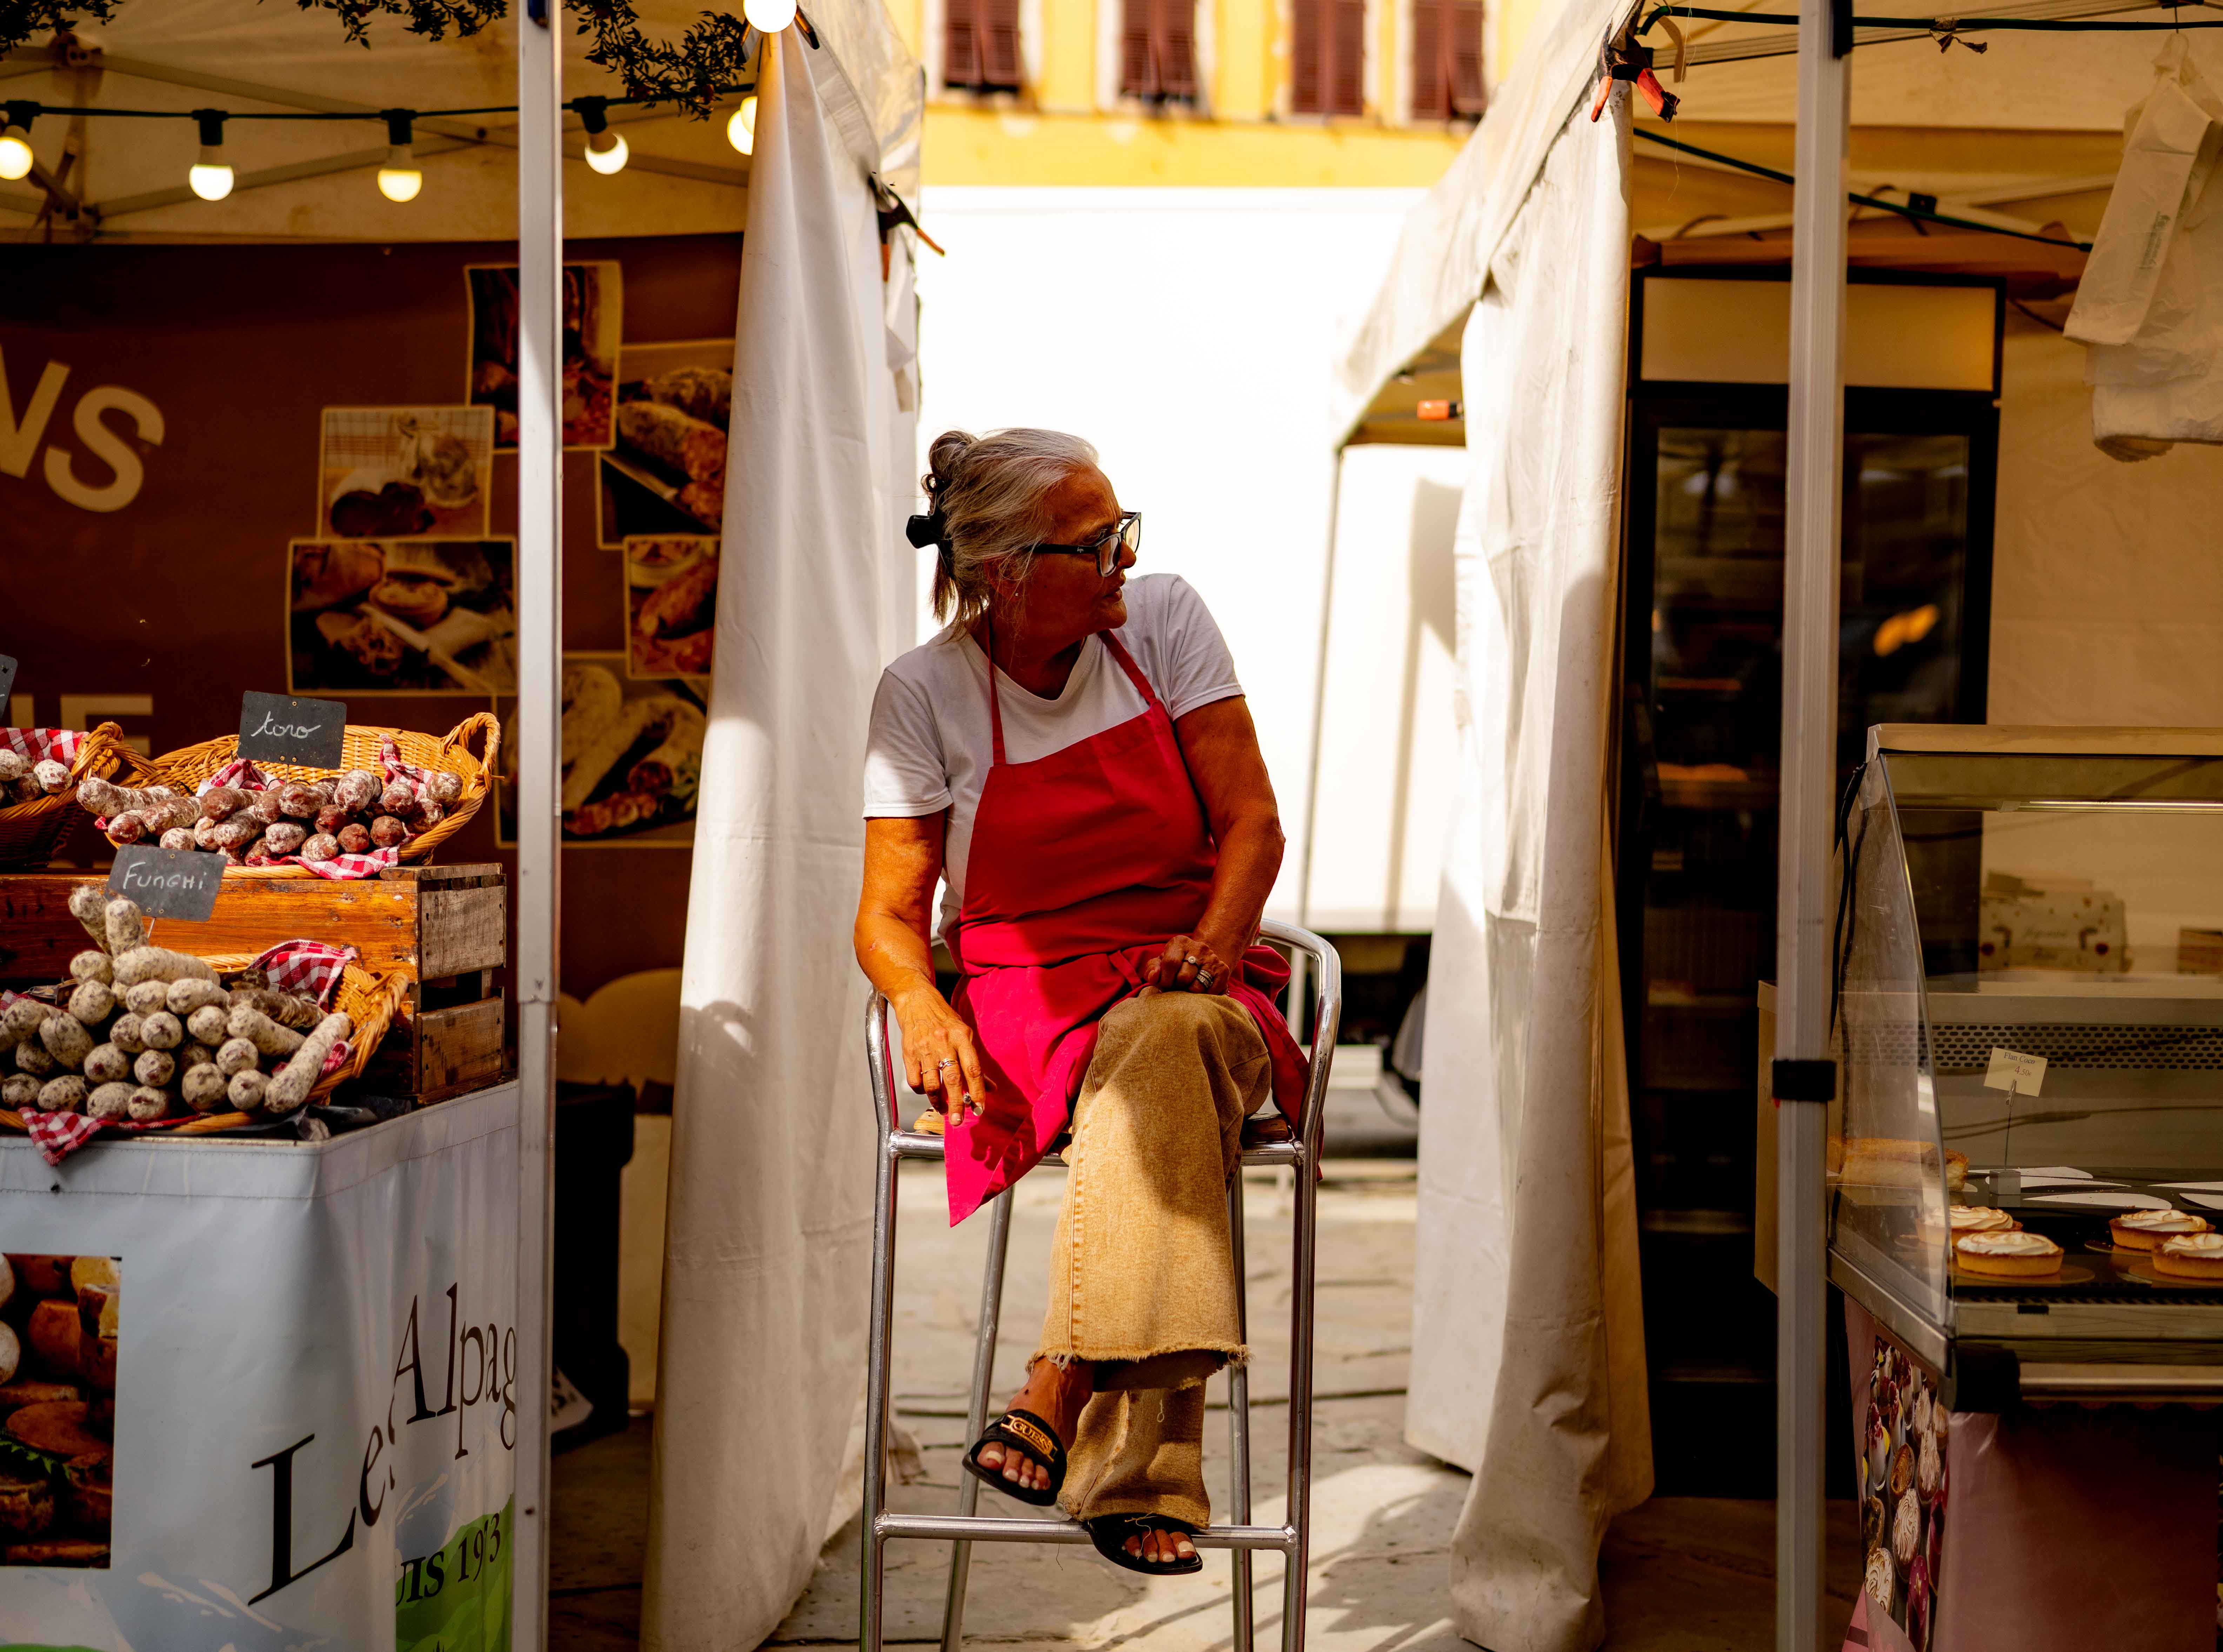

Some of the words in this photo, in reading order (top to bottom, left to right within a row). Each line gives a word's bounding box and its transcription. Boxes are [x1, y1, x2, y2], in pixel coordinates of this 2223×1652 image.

[2004, 1052, 2017, 1061] Flan
[2019, 1055, 2035, 1064] Coco
[2015, 1066, 2032, 1077] 4.50€
[458, 1513, 501, 1582] 193
